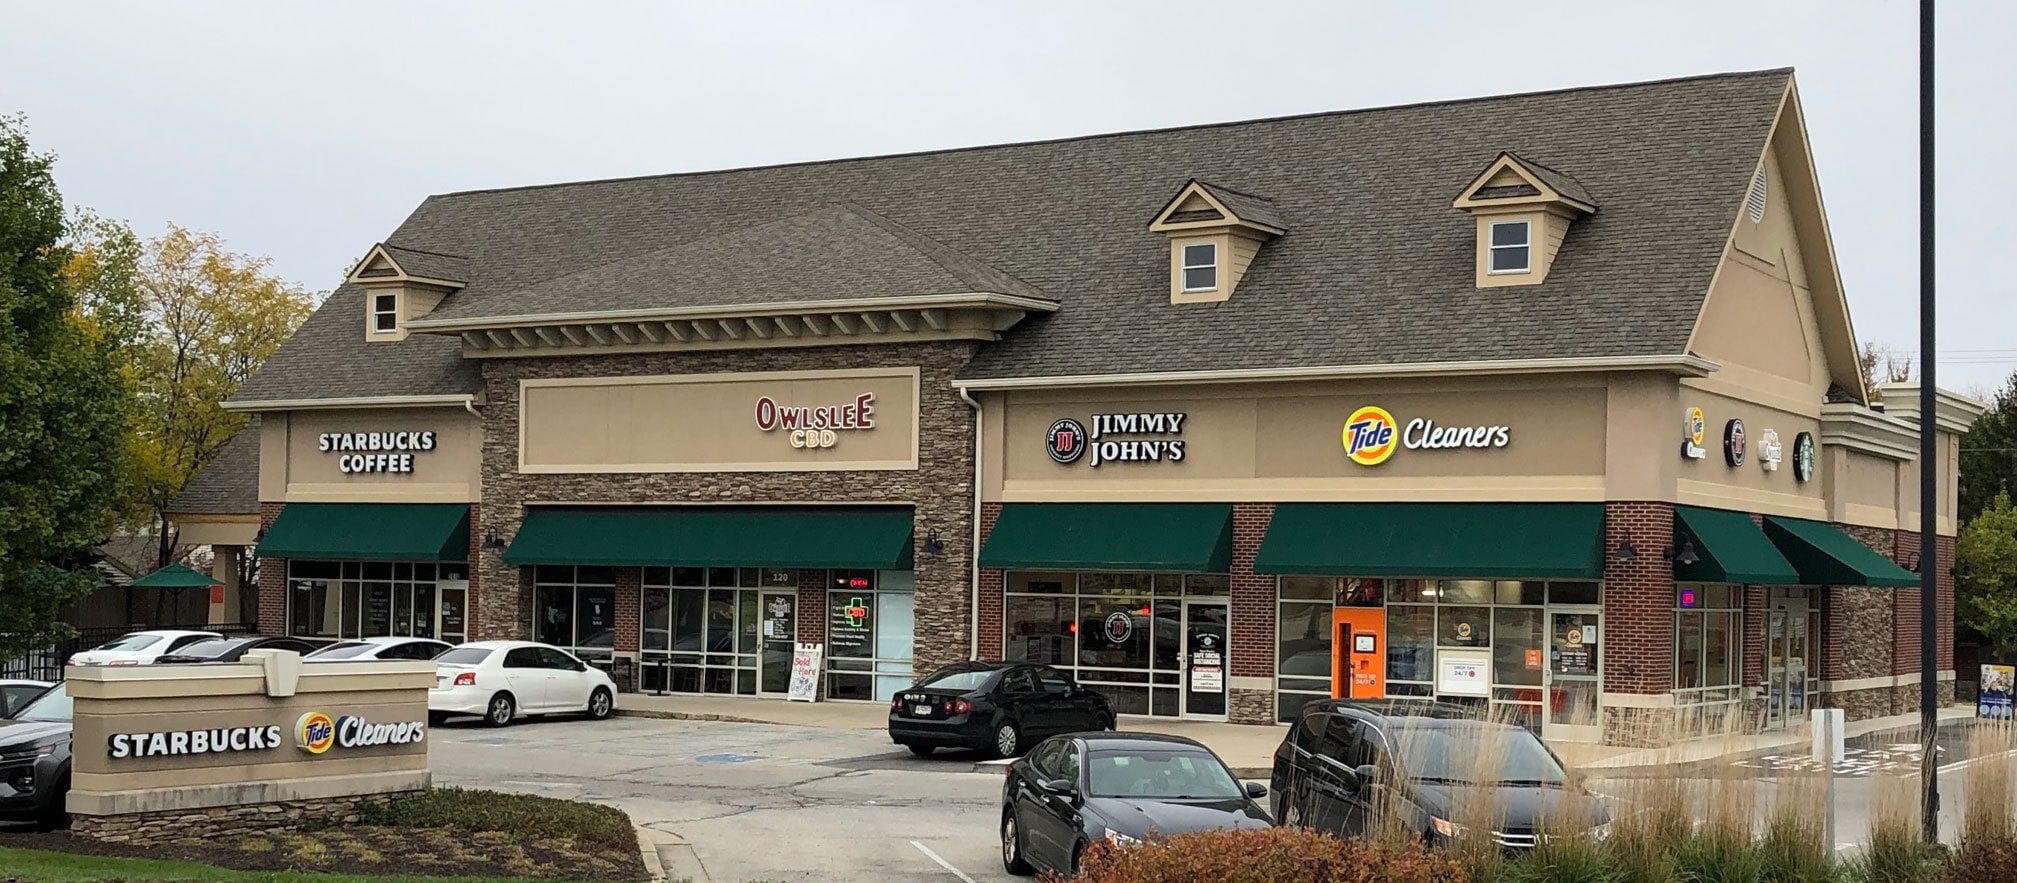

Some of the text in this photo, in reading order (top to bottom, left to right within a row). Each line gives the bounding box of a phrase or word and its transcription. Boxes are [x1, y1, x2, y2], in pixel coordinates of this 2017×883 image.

[1091, 413, 1184, 439] JIMMY
[318, 431, 435, 451] STARBUCKS
[789, 429, 837, 448] CBD
[1056, 431, 1073, 452] JJ
[1347, 417, 1510, 457] Tide Cleaners
[339, 454, 412, 473] COFFEE
[1090, 440, 1183, 467] JOHN'S
[772, 573, 789, 582] 120
[847, 606, 866, 617] CBD
[793, 657, 811, 666] Sold
[304, 714, 425, 748] Tide Cleaners
[111, 724, 283, 759] STARBUCKS
